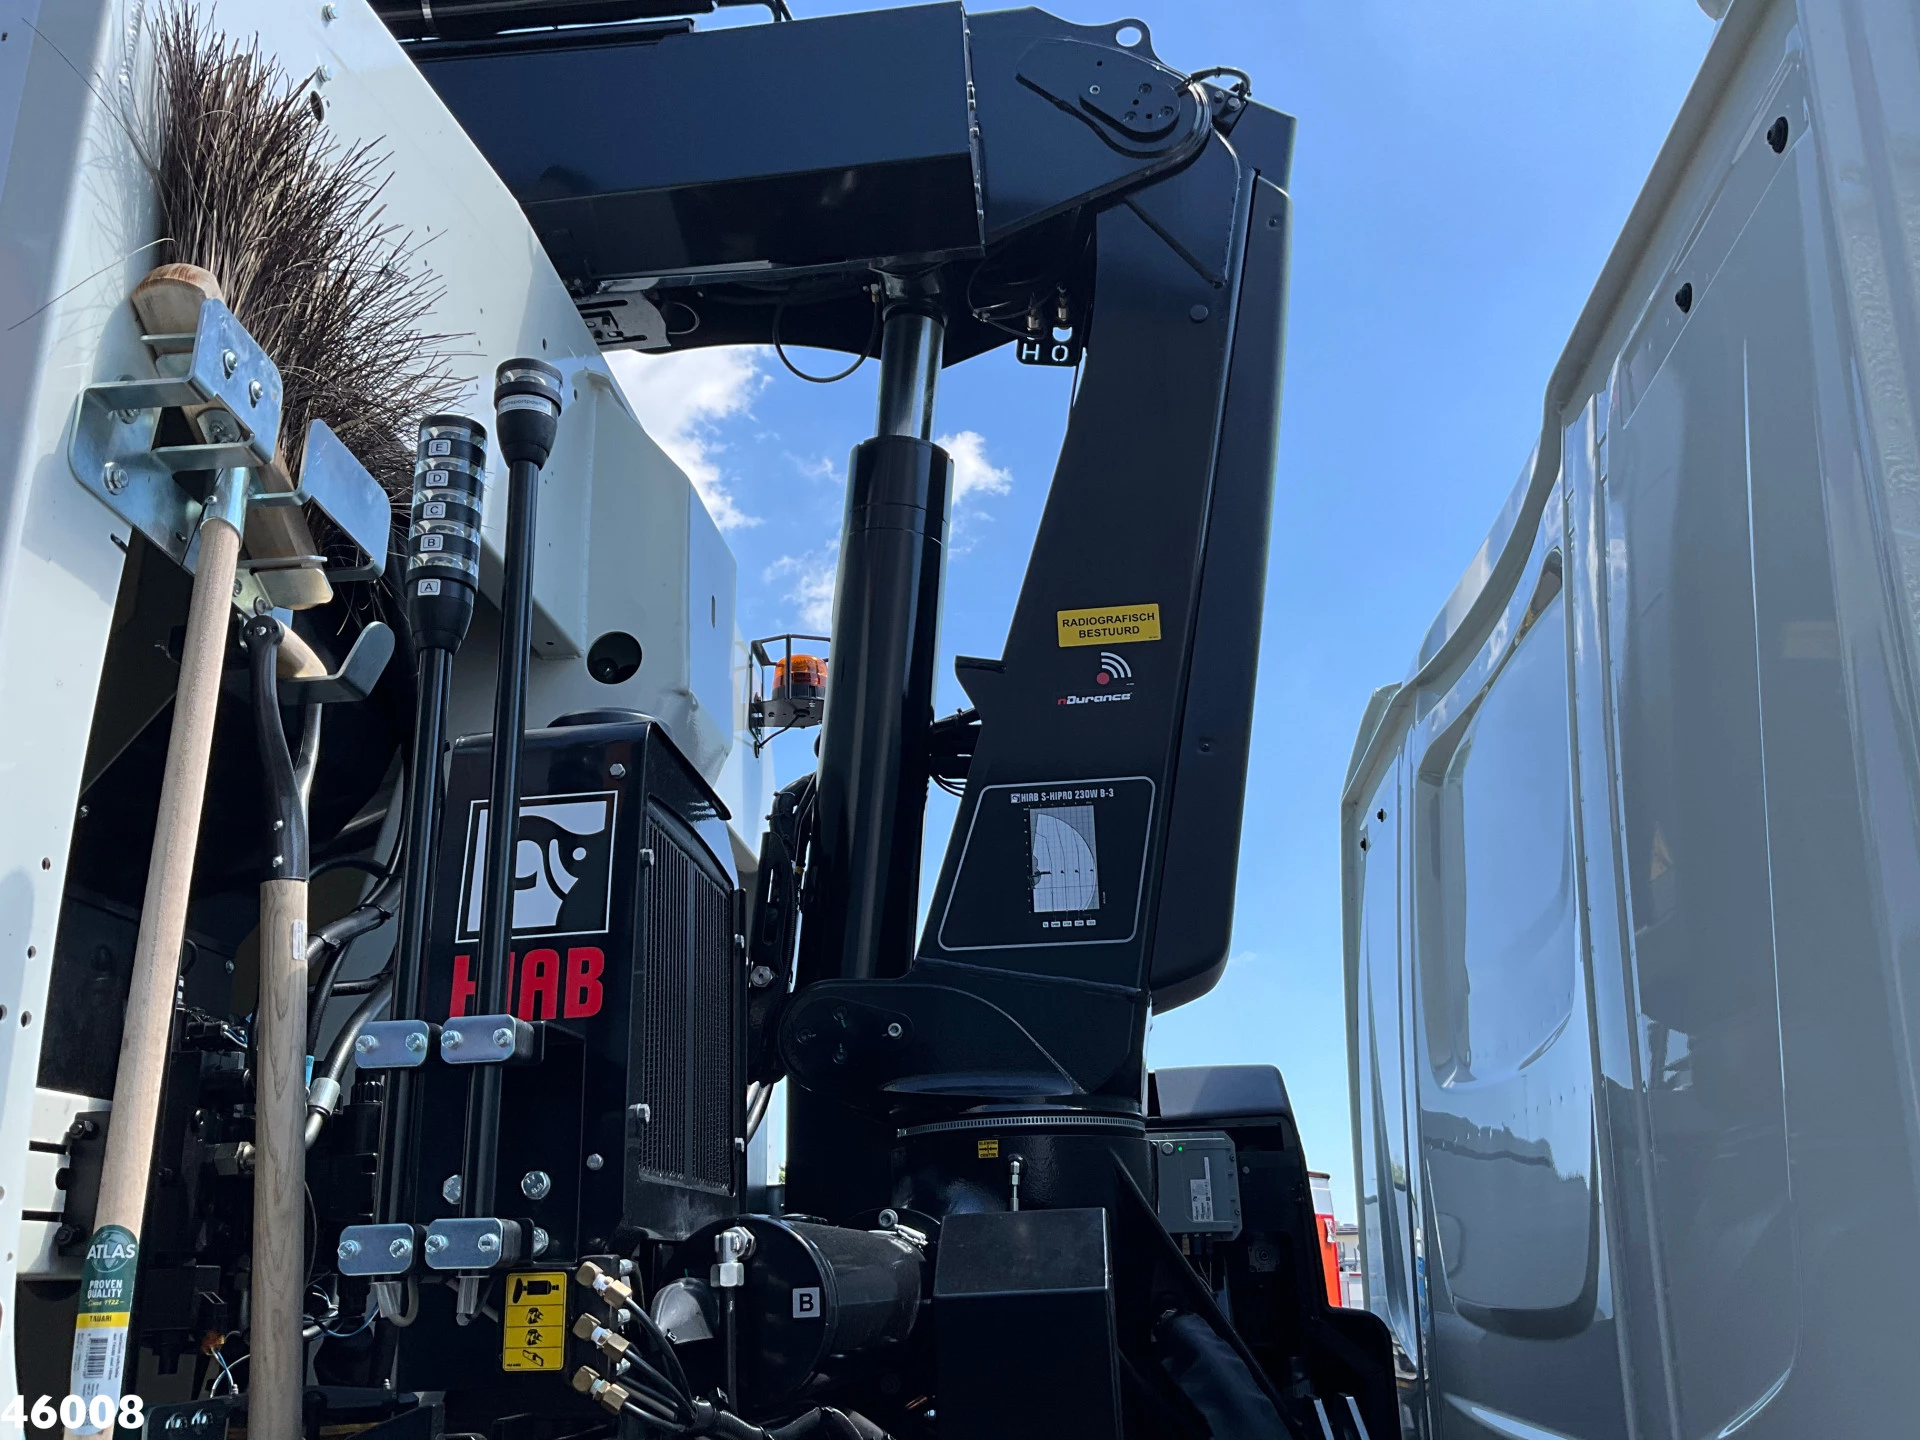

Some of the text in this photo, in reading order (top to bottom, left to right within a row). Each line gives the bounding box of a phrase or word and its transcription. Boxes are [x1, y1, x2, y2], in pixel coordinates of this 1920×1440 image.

[1021, 343, 1069, 362] H O
[435, 443, 444, 452] E
[433, 474, 442, 483] D
[430, 506, 439, 515] C
[427, 539, 436, 547] B
[424, 582, 433, 591] A
[1062, 612, 1155, 628] RADIOGRAFISCH
[1078, 625, 1140, 639] BESTUURD
[1057, 693, 1132, 705] nDurance
[1020, 788, 1114, 803] HIAB S-HIPRO 230W B-3
[86, 1243, 136, 1260] ATLAS
[89, 1279, 123, 1289] PROVEN
[87, 1288, 123, 1300] QUALITY
[799, 1293, 814, 1312] B
